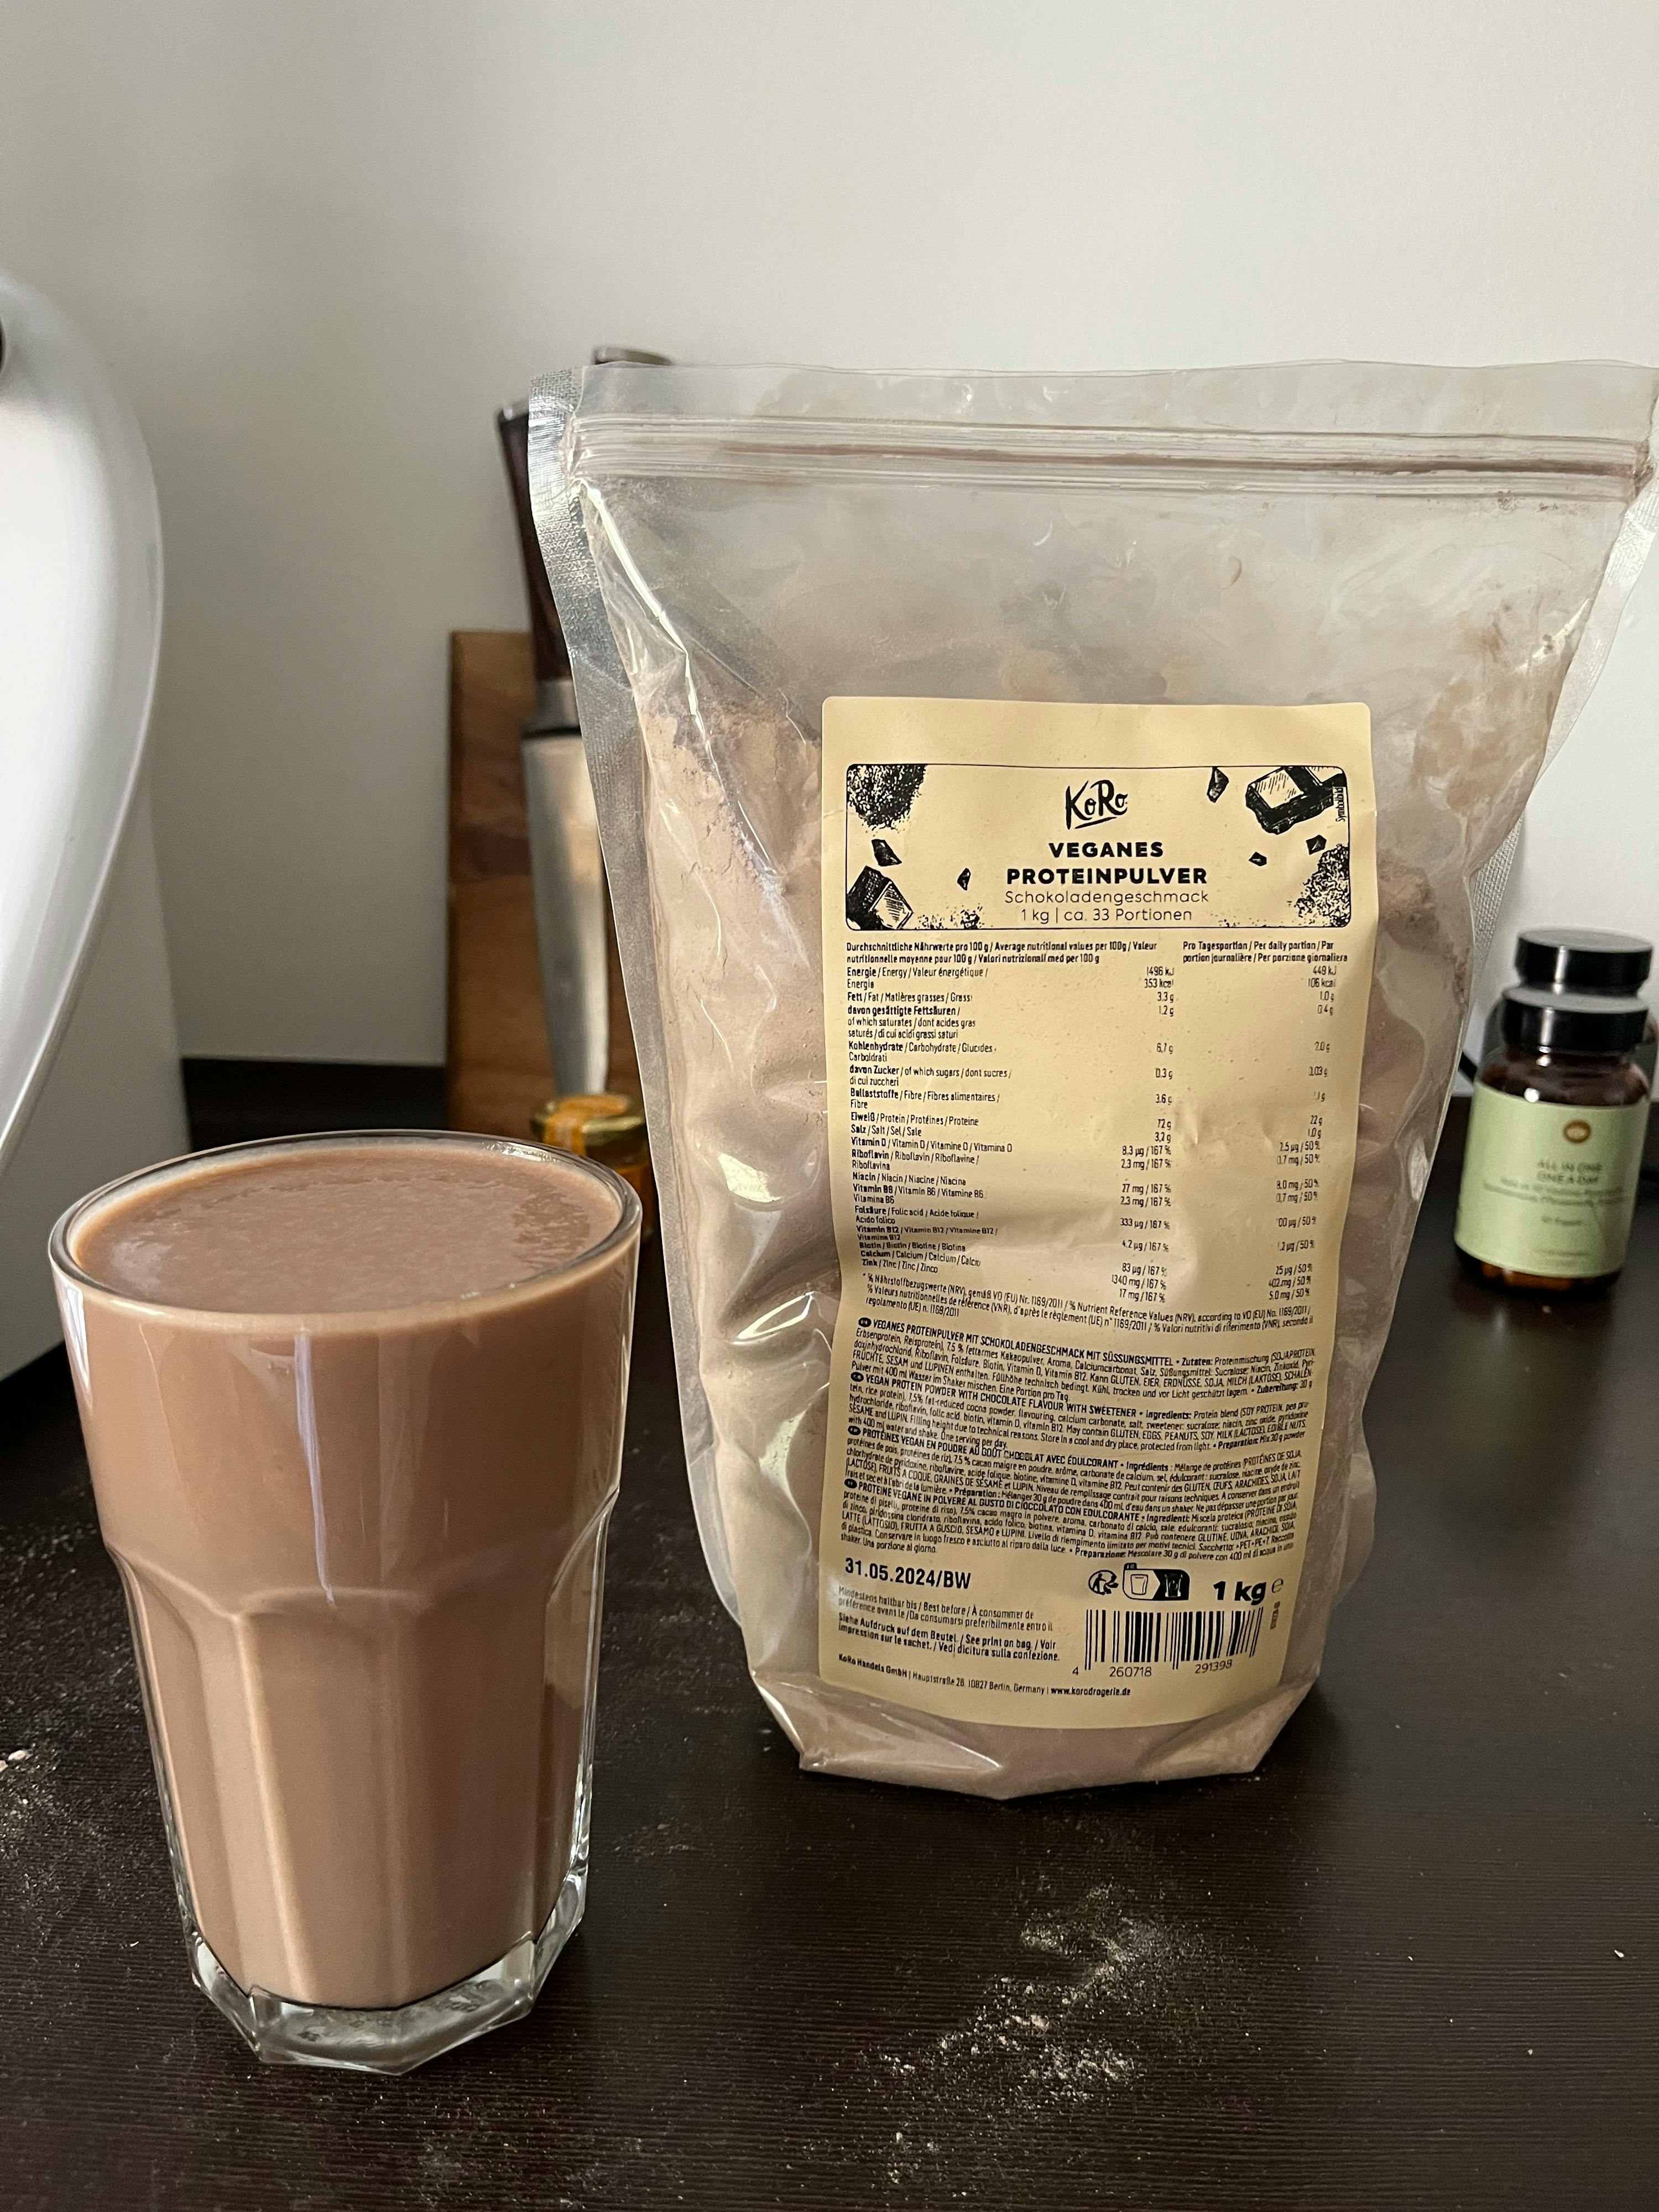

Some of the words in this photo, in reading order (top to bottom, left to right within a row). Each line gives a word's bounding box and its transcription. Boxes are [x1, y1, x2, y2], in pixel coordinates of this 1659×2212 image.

[1048, 841, 1164, 858] VEGANES
[1007, 868, 1207, 885] PROTEINPULVER
[1004, 890, 1209, 906] Schokoladengeschmack
[1021, 909, 1026, 921] 1
[1032, 909, 1049, 925] kg
[1064, 911, 1087, 921] ca.
[1093, 908, 1109, 921] 33
[1116, 908, 1192, 921] Portionen
[955, 943, 968, 953] pro
[969, 941, 983, 951] 100
[984, 943, 989, 953] g
[994, 942, 1025, 953] Average
[1026, 941, 1067, 951] nutritional
[1069, 941, 1093, 951] values
[1095, 943, 1108, 952] per
[1133, 941, 1157, 950] Valeur
[1183, 941, 1196, 950] Pro
[1198, 941, 1248, 952] Tagesportion
[1254, 941, 1266, 950] Per
[1268, 941, 1287, 952] daily
[1288, 940, 1316, 952] portion
[1321, 940, 1334, 950] Par
[899, 956, 932, 965] moyenne
[934, 956, 952, 965] pour
[953, 953, 967, 963] 100
[968, 956, 972, 965] g
[978, 953, 1001, 963] Valori
[1066, 955, 1079, 964] per
[1080, 953, 1093, 963] 100
[1094, 955, 1099, 964] g
[1183, 953, 1210, 964] portion
[1258, 952, 1271, 962] Per
[1272, 954, 1306, 963] porzione
[847, 967, 877, 979] Energie
[882, 967, 907, 979] Energy
[912, 967, 937, 977] Valeur
[938, 967, 983, 979] énergétique
[1146, 966, 1164, 976] 1496
[1312, 965, 1327, 975] 449
[1144, 978, 1157, 989] 353
[847, 992, 863, 1001] Fett
[868, 992, 879, 1002] Fat
[917, 994, 945, 1004] grasses
[848, 1005, 870, 1015] davon
[848, 1016, 855, 1026] of
[856, 1017, 878, 1026] which
[879, 1018, 912, 1027] saturates
[917, 1017, 935, 1027] dont
[936, 1018, 959, 1027] acides
[961, 1020, 975, 1030] gras
[848, 1040, 904, 1053] Kohlenhydrate
[909, 1041, 956, 1054] Carbohydrate
[849, 1064, 872, 1074] davon
[873, 1065, 900, 1075] Zucker
[904, 1066, 912, 1076] of
[913, 1067, 935, 1076] which
[936, 1070, 959, 1079] sugars
[965, 1068, 982, 1077] dont
[904, 1089, 922, 1100] Fibre
[927, 1091, 949, 1101] Fibres
[880, 1113, 905, 1123] Protein
[948, 1116, 979, 1126] Proteine
[873, 1319, 905, 1333] VEGANES
[906, 1324, 964, 1343] PROTEINPULVER
[965, 1333, 979, 1344] MIT
[980, 1335, 1084, 1359] SCHOKOLADENGESCHMACK
[1086, 1350, 1102, 1360] MIT
[865, 1373, 890, 1386] VEGAN
[891, 1378, 922, 1392] PROTEIN
[925, 1384, 956, 1397] POWDER
[958, 1389, 978, 1401] WITH
[980, 1392, 1026, 1407] CHOCOLATE
[1028, 1396, 1064, 1411] FLAVOUR
[1066, 1402, 1087, 1413] WITH
[1089, 1405, 1136, 1417] SWEETENER
[932, 1495, 966, 1506] POLVERE
[967, 1498, 978, 1506] AL
[979, 1498, 1005, 1508] GUSTO
[845, 1557, 971, 1589] 31.05.2024/BW
[1213, 1580, 1226, 1601] 1
[1234, 1581, 1267, 1606] kg
[924, 1601, 940, 1613] Best
[941, 1604, 966, 1615] before
[1025, 1610, 1034, 1620] de
[860, 1617, 895, 1633] Aufdruck
[896, 1626, 910, 1636] auf
[911, 1627, 928, 1639] dem
[965, 1634, 980, 1645] See
[1004, 1640, 1014, 1648] on
[1040, 1639, 1056, 1650] Voir
[880, 1634, 893, 1643] sur
[894, 1635, 902, 1645] le
[991, 1647, 1011, 1658] sulla
[1072, 1666, 1079, 1676] 4
[1109, 1666, 1152, 1677] 260718
[885, 1665, 907, 1678] GmbH
[968, 1679, 988, 1689] 10827
[1013, 1683, 1045, 1695] Germany
